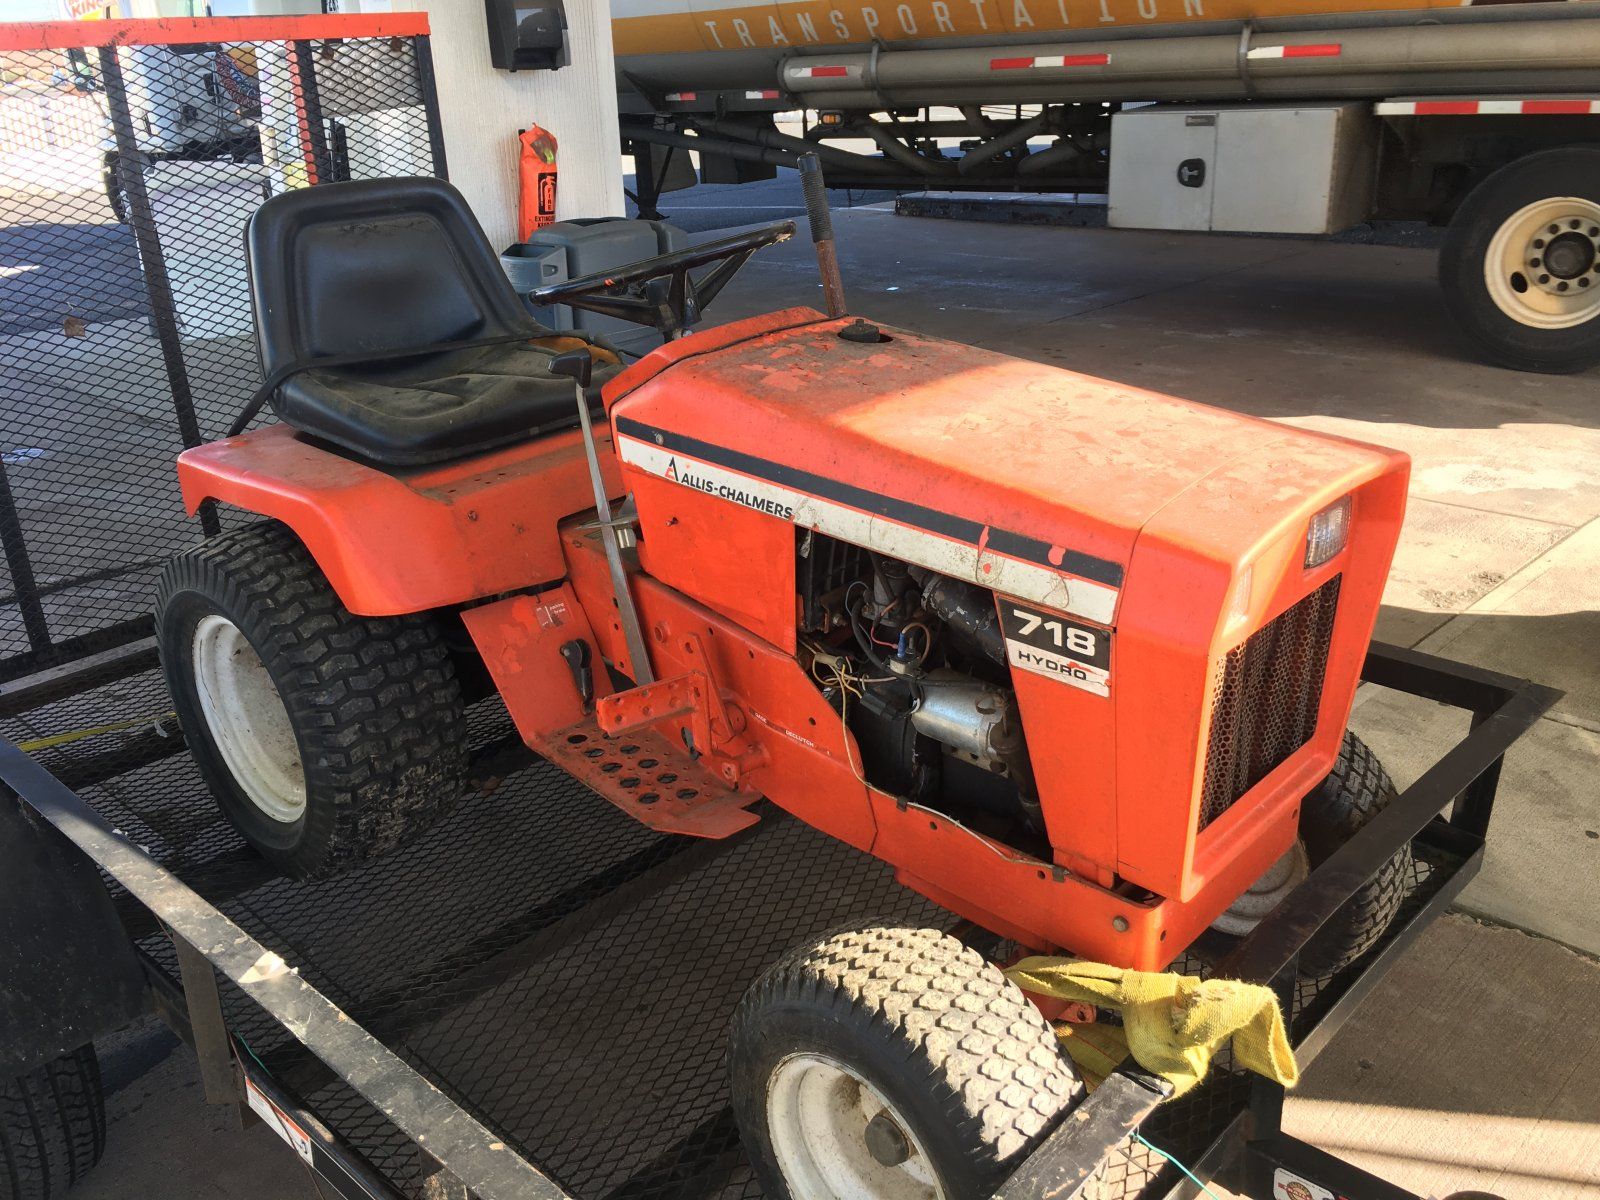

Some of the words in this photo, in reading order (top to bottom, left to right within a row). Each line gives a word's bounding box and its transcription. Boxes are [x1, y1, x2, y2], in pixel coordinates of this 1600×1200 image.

[681, 473, 793, 518] ALLIS-CHALMERS
[1013, 609, 1096, 657] 718
[1018, 650, 1087, 681] HYDRO
